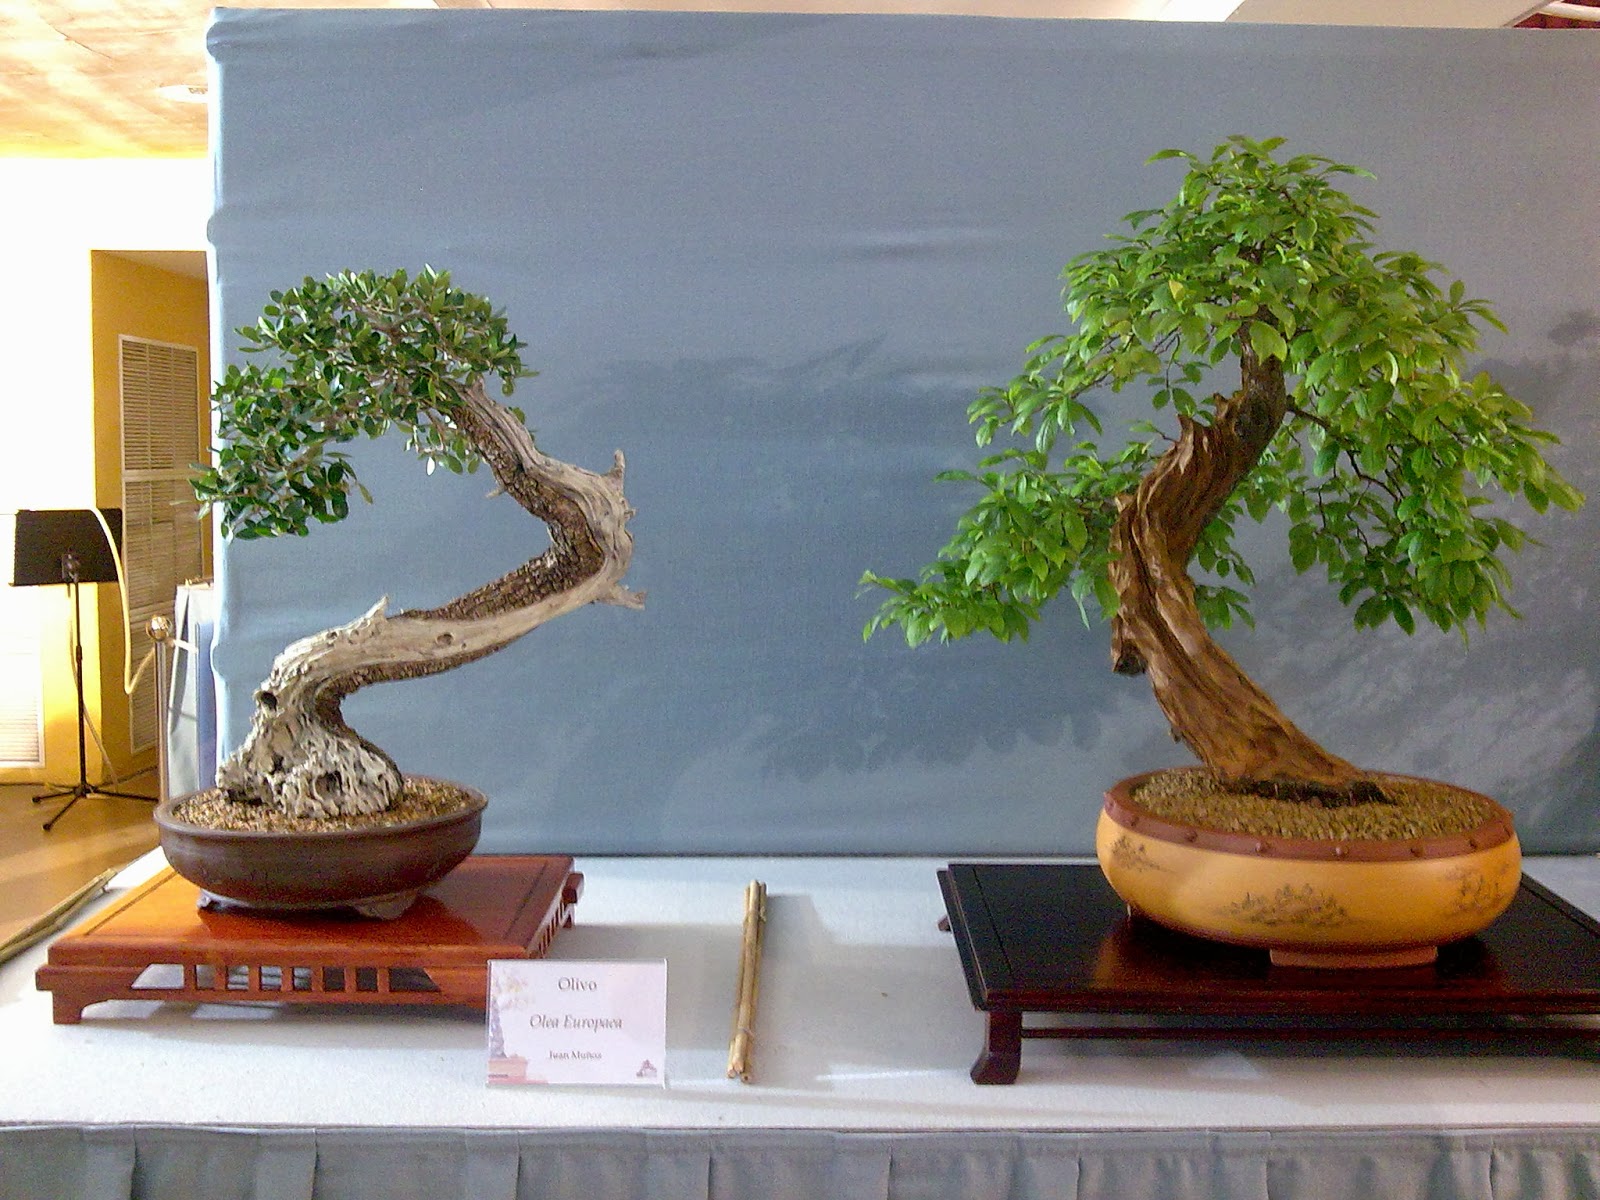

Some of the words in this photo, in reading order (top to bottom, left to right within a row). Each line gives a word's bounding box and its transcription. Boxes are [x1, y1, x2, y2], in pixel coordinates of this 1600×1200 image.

[558, 977, 597, 991] Olivo
[529, 1014, 559, 1029] Olea
[563, 1014, 623, 1033] Europaea
